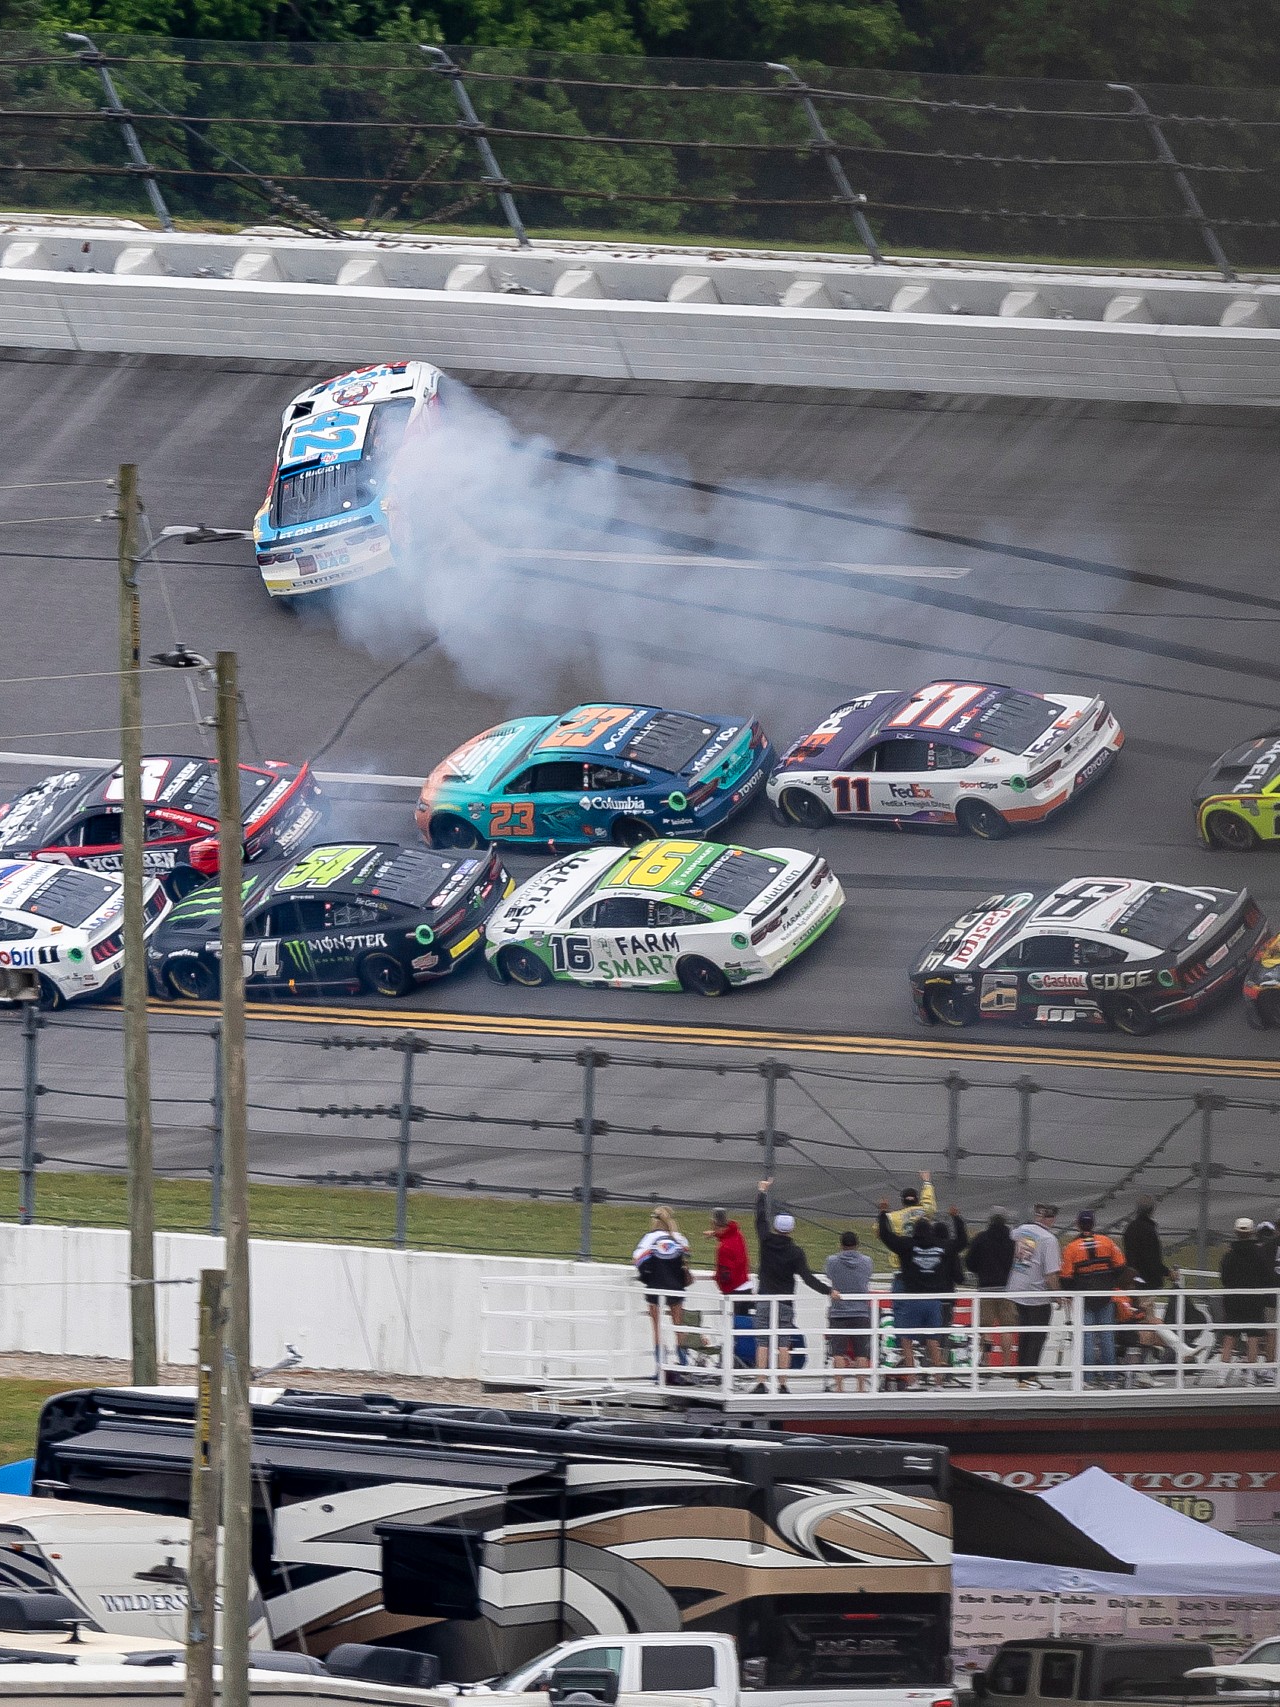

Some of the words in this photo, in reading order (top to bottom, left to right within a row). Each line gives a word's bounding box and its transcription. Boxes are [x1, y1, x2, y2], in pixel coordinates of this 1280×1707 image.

[290, 411, 360, 458] 42
[888, 682, 987, 729] 11
[538, 708, 635, 748] 23
[738, 768, 764, 797] TOYOTA
[832, 776, 871, 812] 11
[889, 783, 933, 798] FedEx
[489, 802, 535, 836] 23
[592, 796, 645, 810] Columbia
[274, 845, 377, 891] 54
[608, 840, 702, 887] 16
[762, 869, 801, 905] Nutrien
[615, 932, 680, 955] FARM
[951, 898, 1015, 963] Castrol
[549, 933, 594, 973] 16
[598, 954, 679, 979] SMART
[1042, 974, 1085, 988] Castrol
[1091, 970, 1153, 990] EDGE
